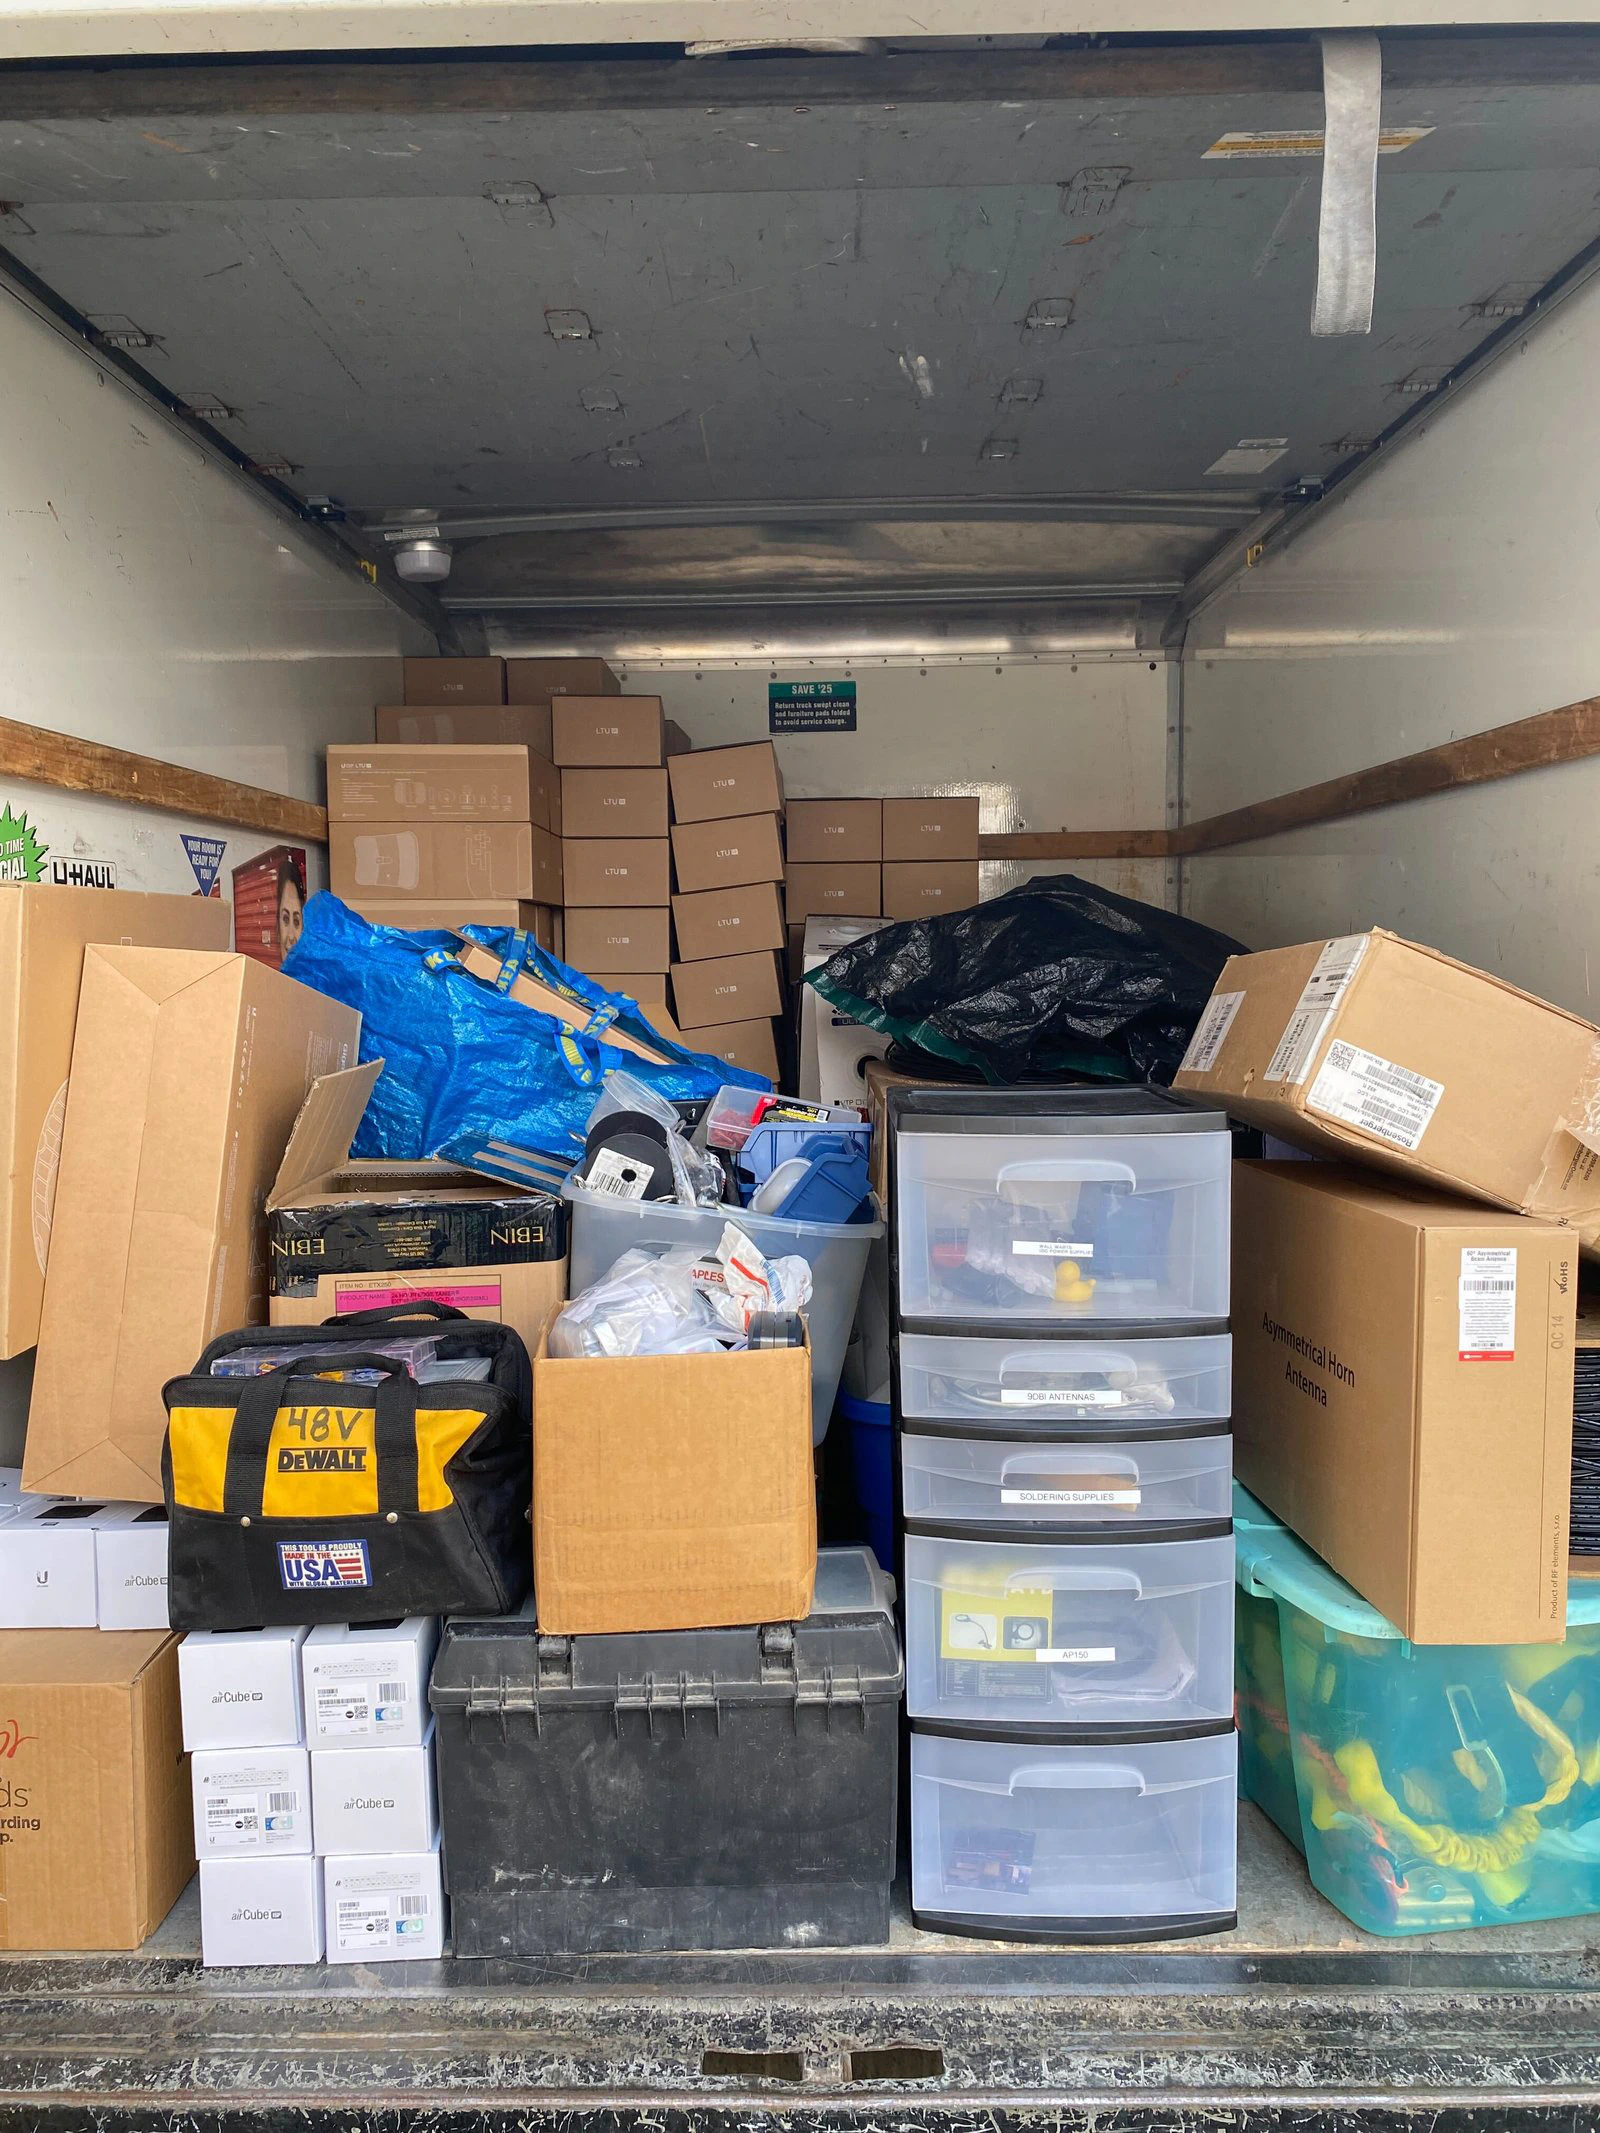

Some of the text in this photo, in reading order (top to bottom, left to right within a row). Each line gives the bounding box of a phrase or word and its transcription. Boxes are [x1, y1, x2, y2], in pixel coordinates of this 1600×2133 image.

[792, 685, 814, 694] SAVE
[6, 838, 24, 854] TIME
[188, 840, 200, 850] YOUR
[201, 842, 216, 853] ROOM
[192, 855, 219, 868] READY FOR
[1360, 1118, 1413, 1147] Rosenberger
[491, 1226, 544, 1245] EBIN
[272, 1238, 325, 1256] EBIN
[1560, 1261, 1568, 1291] RoHS
[1551, 1316, 1564, 1349] QC 14
[1263, 1312, 1354, 1388] Asymmetrical Horn
[1286, 1361, 1327, 1407] Antenna
[288, 1407, 364, 1442] 48V
[285, 1560, 341, 1580] USA
[1552, 1570, 1558, 1579] RF
[125, 1575, 159, 1586] airCube
[1062, 1650, 1089, 1659] AP150
[212, 1691, 250, 1703] airCube
[344, 1798, 382, 1809] airCube
[232, 1909, 269, 1920] airCube
